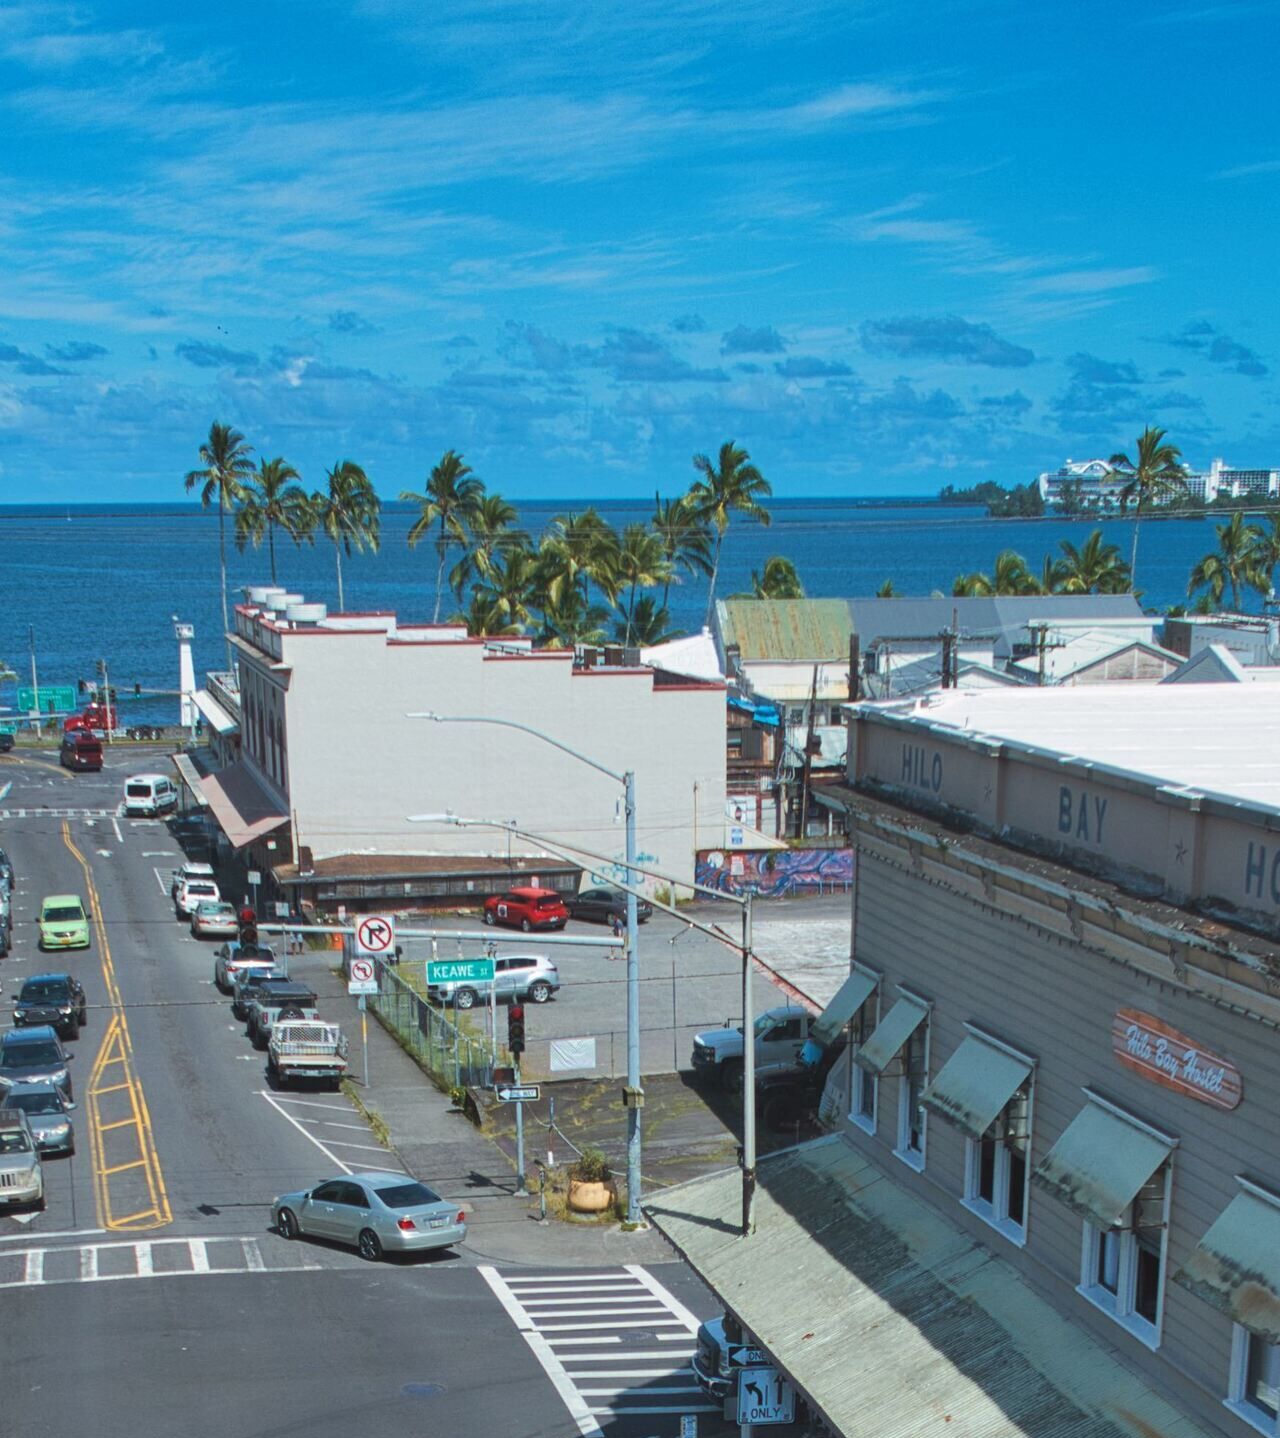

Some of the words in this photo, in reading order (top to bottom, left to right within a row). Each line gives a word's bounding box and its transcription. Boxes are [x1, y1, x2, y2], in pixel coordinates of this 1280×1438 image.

[902, 743, 943, 793] HILO
[1059, 786, 1108, 843] BAY
[433, 965, 475, 979] KEAWE
[1126, 1024, 1152, 1060] Hilo
[1154, 1039, 1180, 1080] Bay
[1183, 1049, 1225, 1093] Hostel
[751, 1407, 781, 1419] ONLY
